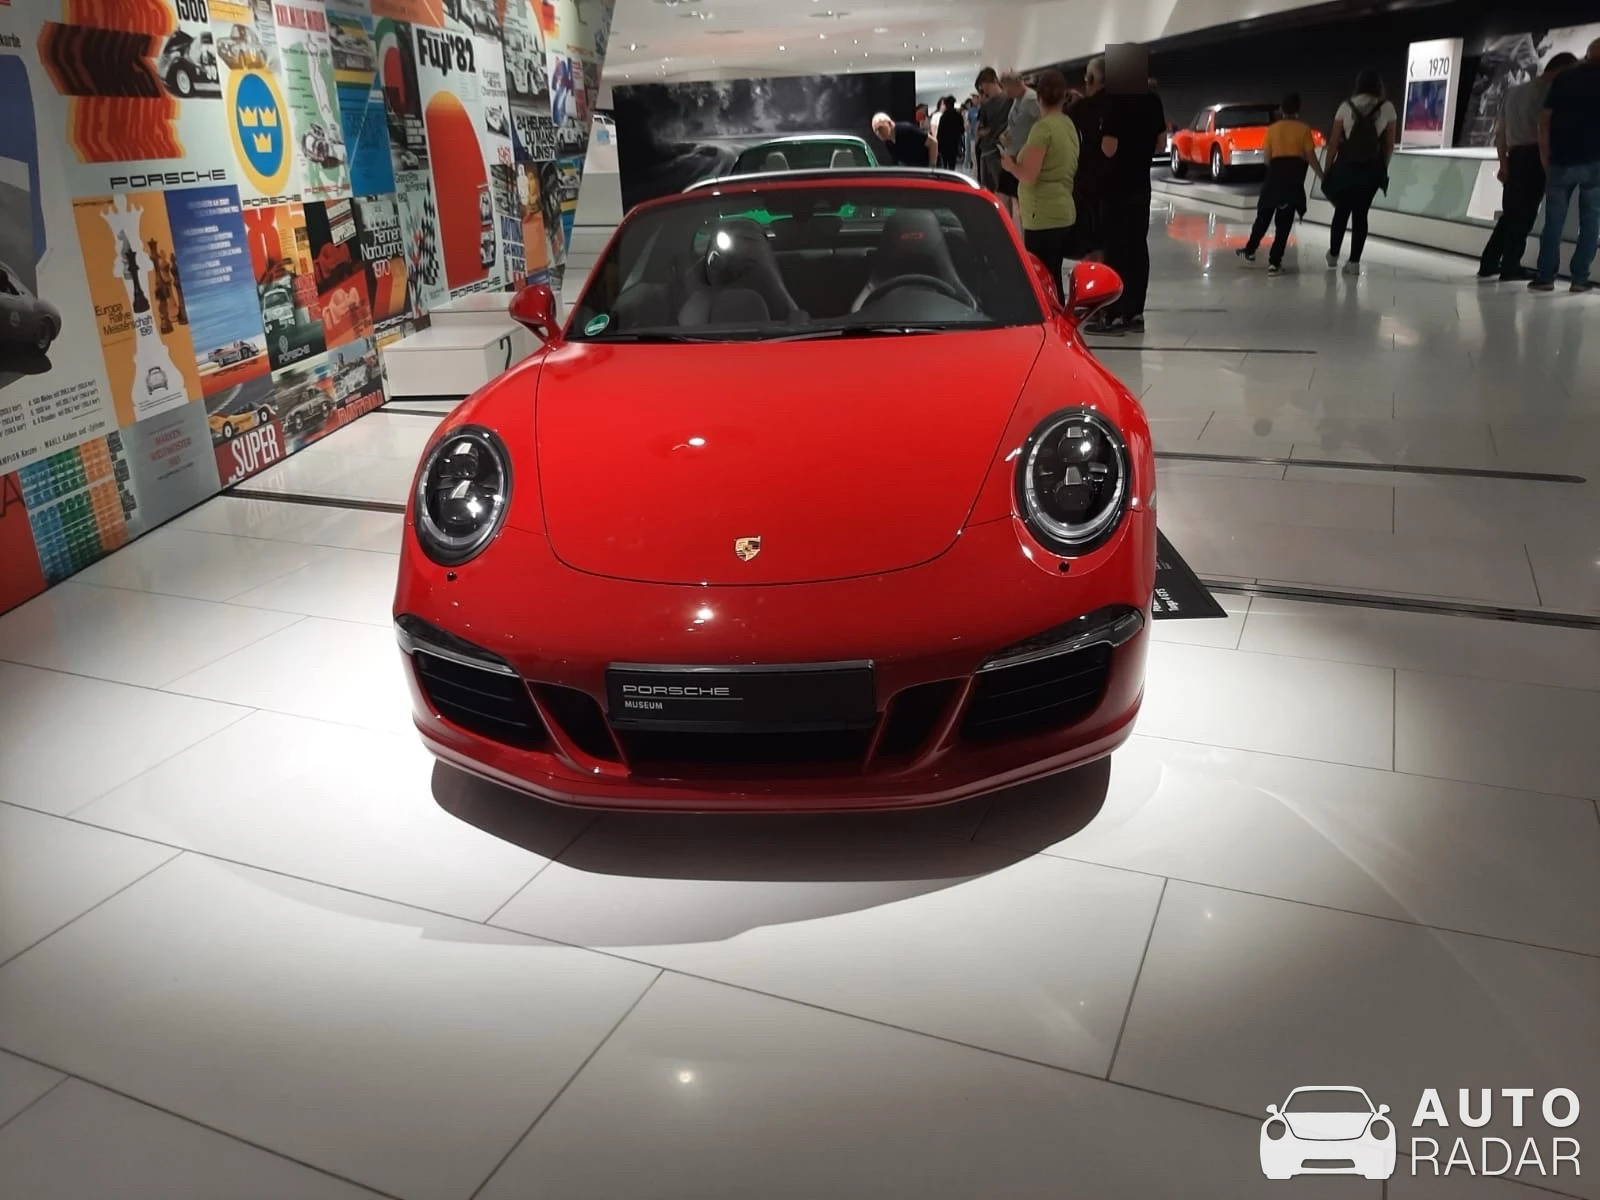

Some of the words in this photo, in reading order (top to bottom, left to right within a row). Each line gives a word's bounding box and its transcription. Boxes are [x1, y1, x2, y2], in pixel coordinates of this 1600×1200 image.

[1429, 57, 1450, 76] 1970
[110, 169, 226, 189] PORSCHE
[243, 194, 301, 206] PORSCHE
[372, 259, 390, 278] 1970
[450, 276, 500, 301] PORSCHE
[95, 303, 123, 317] Europa
[374, 311, 413, 330] PORSCHE
[278, 345, 310, 364] PORSCHE
[232, 424, 280, 477] SUPER
[622, 685, 730, 696] PORSCHE
[624, 701, 663, 710] MUSEUM
